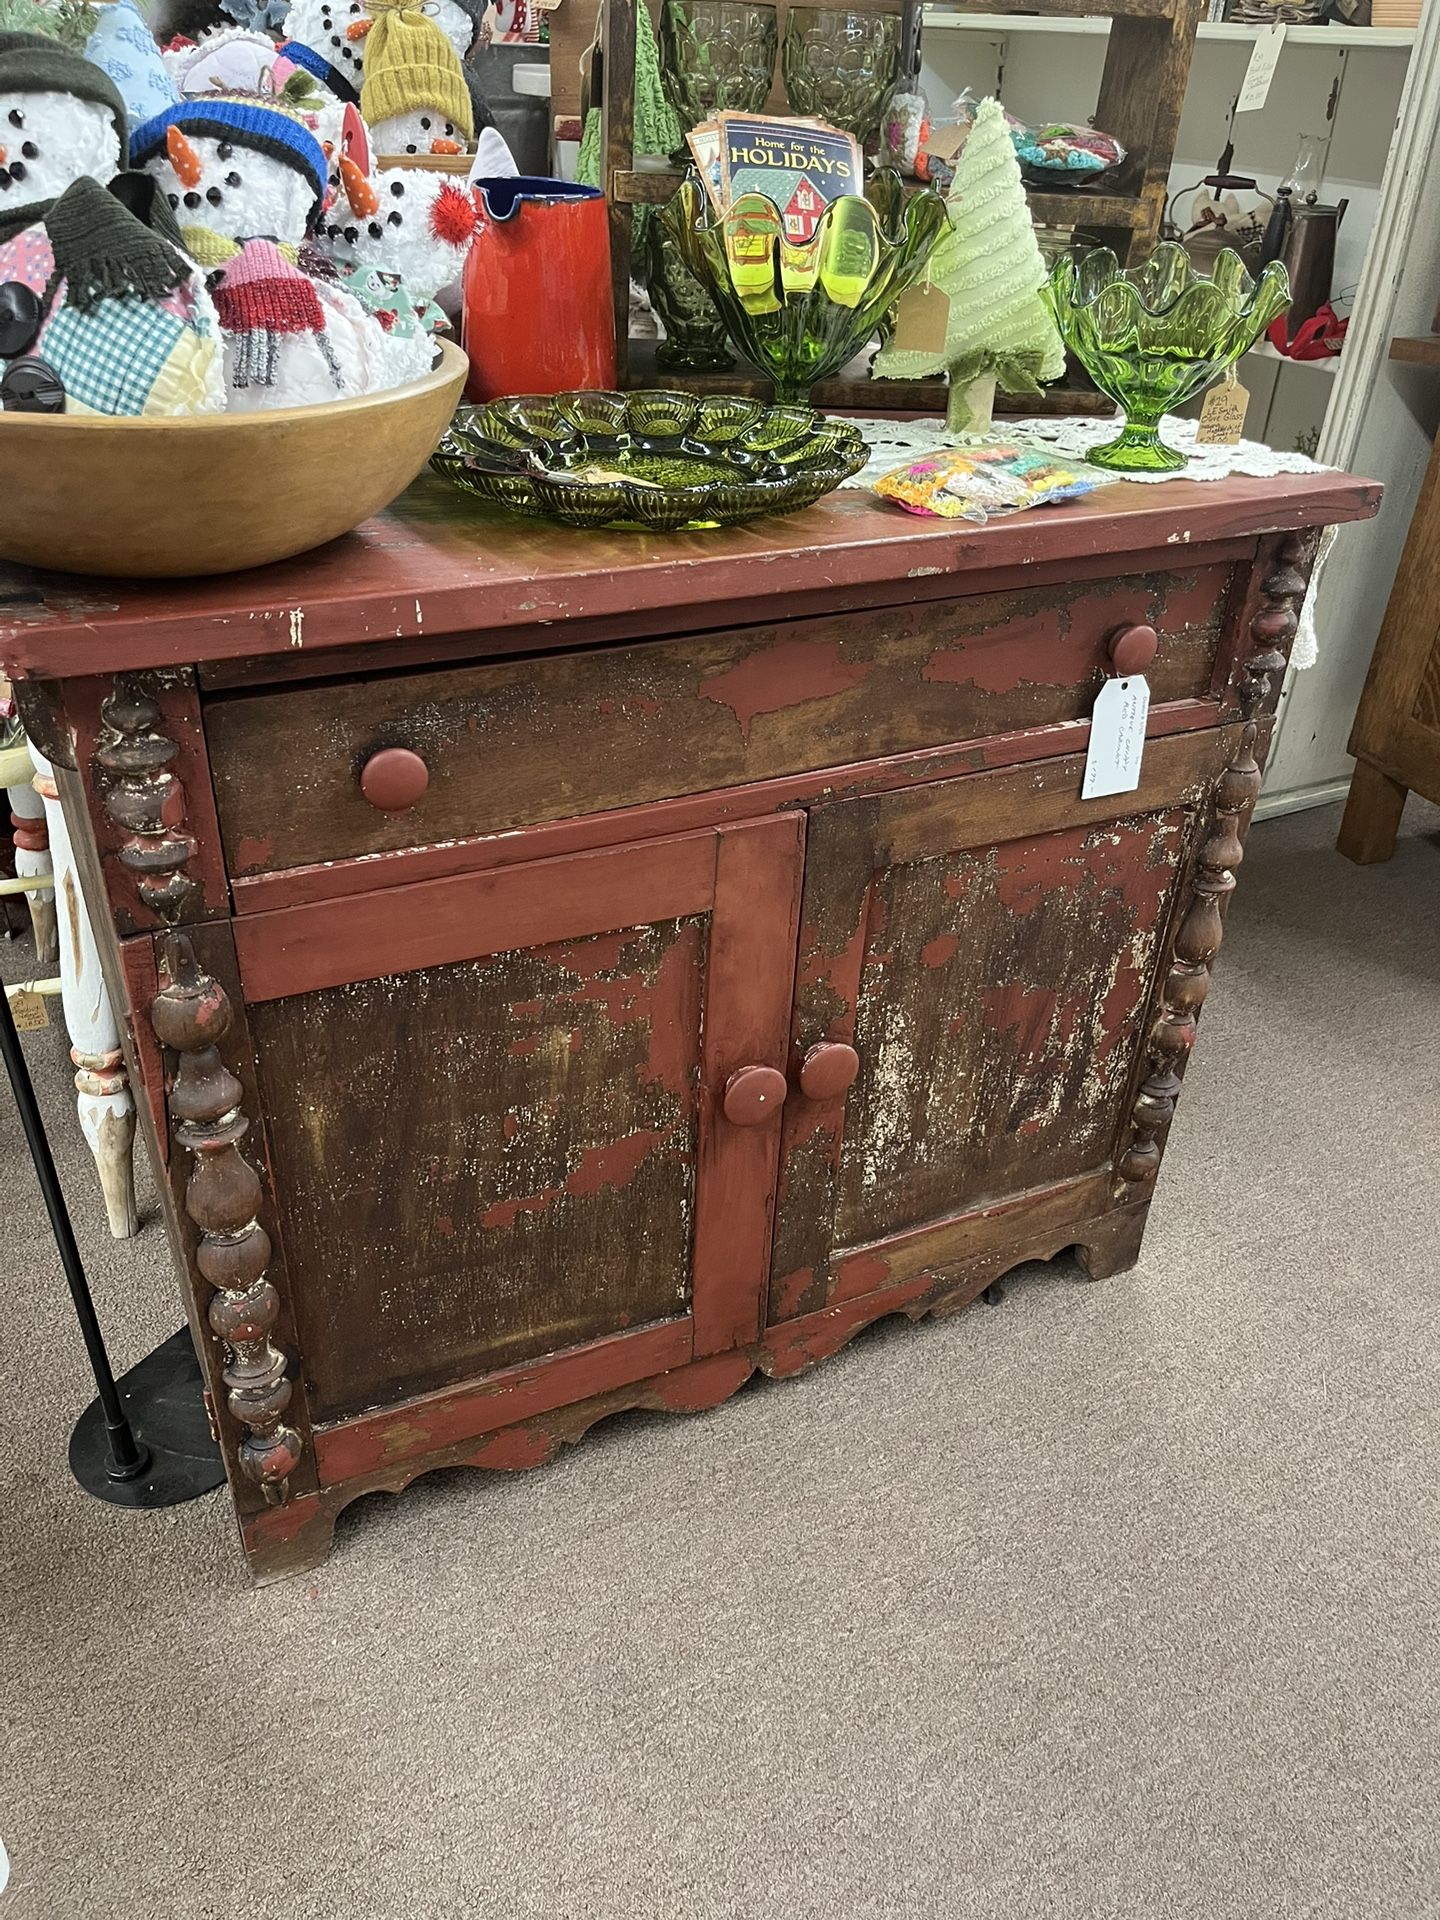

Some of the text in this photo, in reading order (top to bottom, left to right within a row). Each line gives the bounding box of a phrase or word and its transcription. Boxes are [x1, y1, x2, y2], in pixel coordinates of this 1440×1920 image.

[755, 137, 826, 156] Home for the
[731, 147, 851, 178] HOLIDAYS
